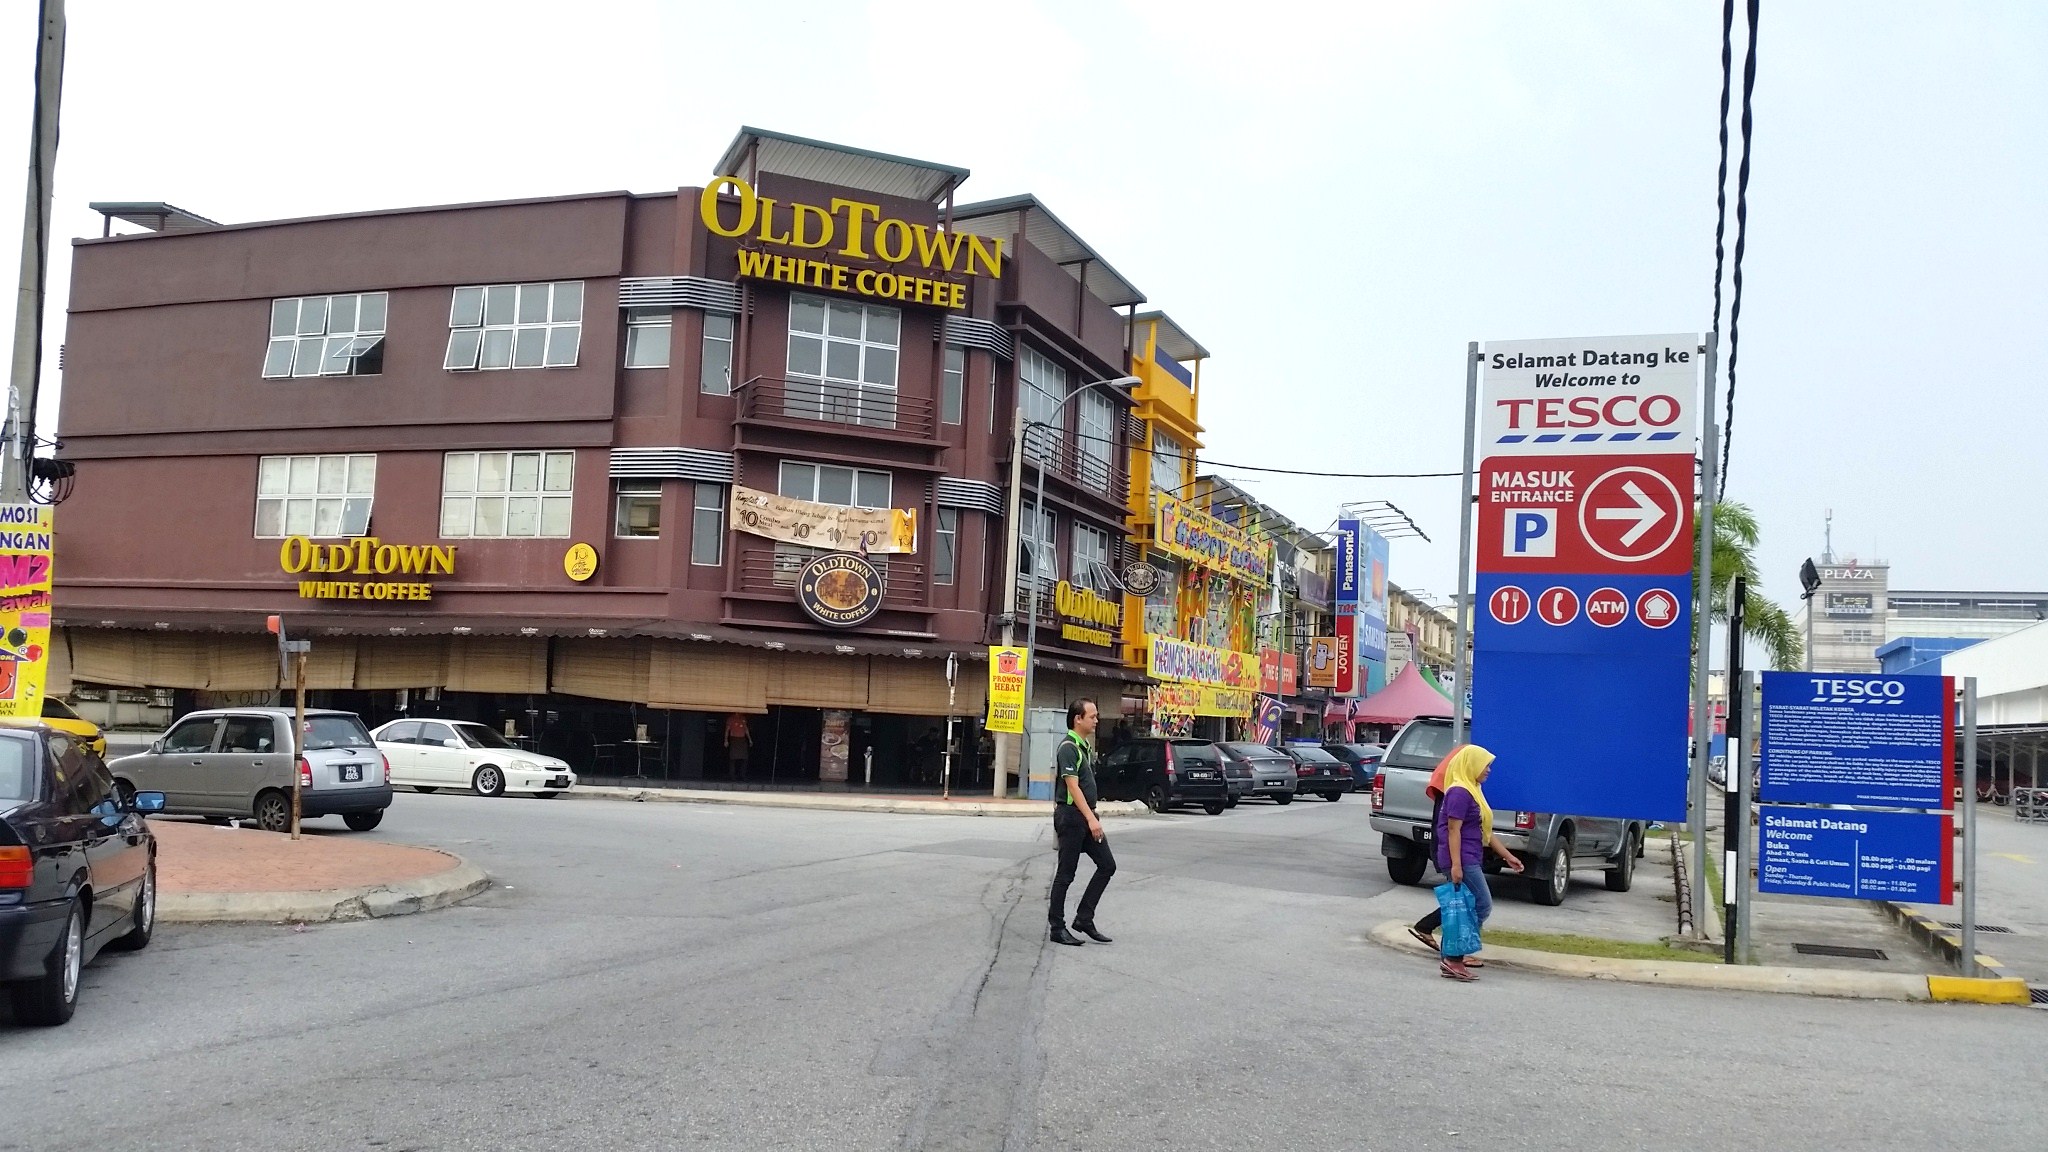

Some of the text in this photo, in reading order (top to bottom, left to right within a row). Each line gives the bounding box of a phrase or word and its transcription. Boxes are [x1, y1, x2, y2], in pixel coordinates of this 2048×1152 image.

[700, 175, 1005, 279] OLDTOWN
[737, 249, 967, 309] WHITE COFFEE
[1492, 347, 1690, 370] Selamat Datang ke
[1535, 372, 1641, 388] Welcome to
[1496, 394, 1682, 429] TESCO
[1491, 470, 1575, 488] MASUK
[1491, 490, 1574, 503] ENTRANCE
[1514, 513, 1549, 553] P
[280, 535, 458, 575] OLDTOWN
[1342, 529, 1355, 591] Panasonic
[811, 556, 873, 579] OLDTOWN
[1824, 569, 1874, 579] PLAZA
[298, 580, 432, 601] WHITE COFFEE
[813, 602, 869, 620] WHITE COFFEE
[1056, 580, 1120, 627] OLDTOWN
[1589, 600, 1625, 614] ATM
[1062, 623, 1113, 648] WHITE COFFEE
[1338, 634, 1348, 675] JOVEN
[993, 675, 1024, 684] PROMOSI
[1265, 663, 1275, 681] THE
[994, 682, 1022, 692] HEBAT
[1810, 678, 1905, 698] TESCO
[993, 708, 1019, 720] RASMI
[1765, 815, 1868, 834] Selamat Datang
[1766, 829, 1813, 841] Welcome
[1766, 841, 1790, 850] Buka
[1765, 864, 1788, 873] Open
[1880, 856, 1894, 864] pagi
[1783, 879, 1807, 887] Saturday
[1829, 881, 1851, 890] Holiday
[1788, 873, 1814, 881] Thursday
